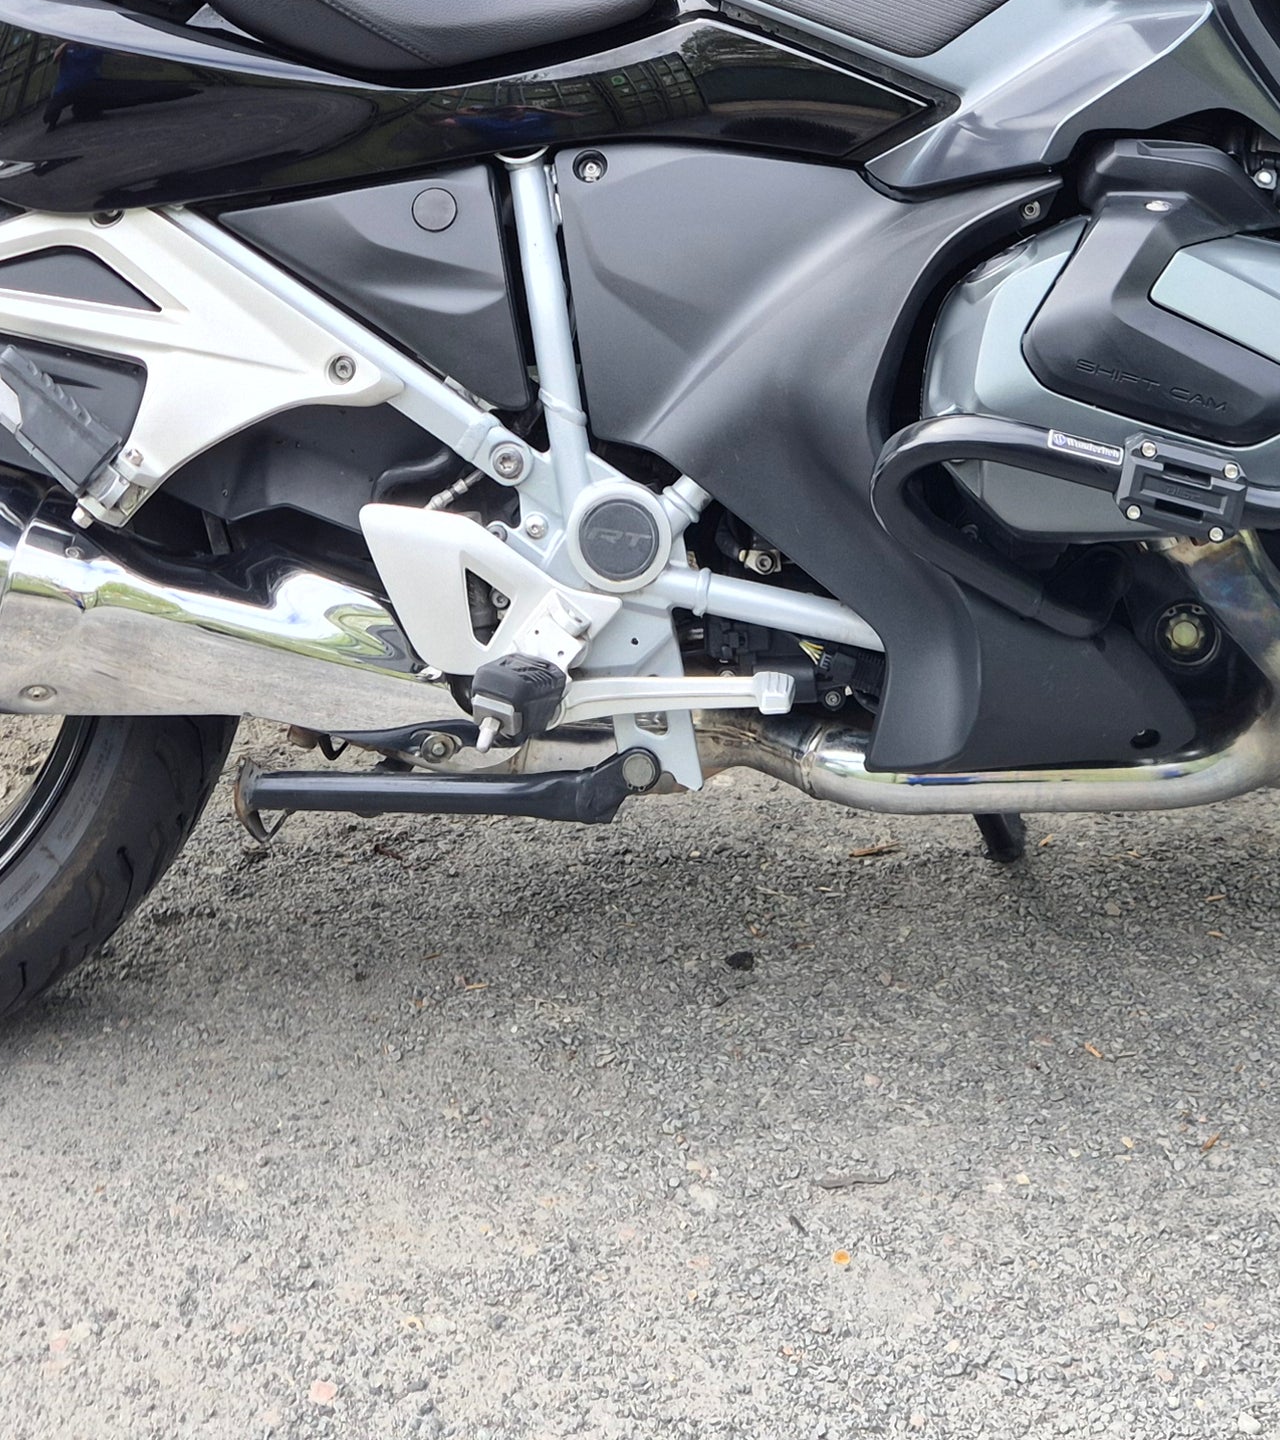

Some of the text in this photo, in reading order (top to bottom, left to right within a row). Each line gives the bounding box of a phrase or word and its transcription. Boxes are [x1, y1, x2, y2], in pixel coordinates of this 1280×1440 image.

[1076, 359, 1228, 412] SHIFT CAM
[586, 527, 652, 547] RT
